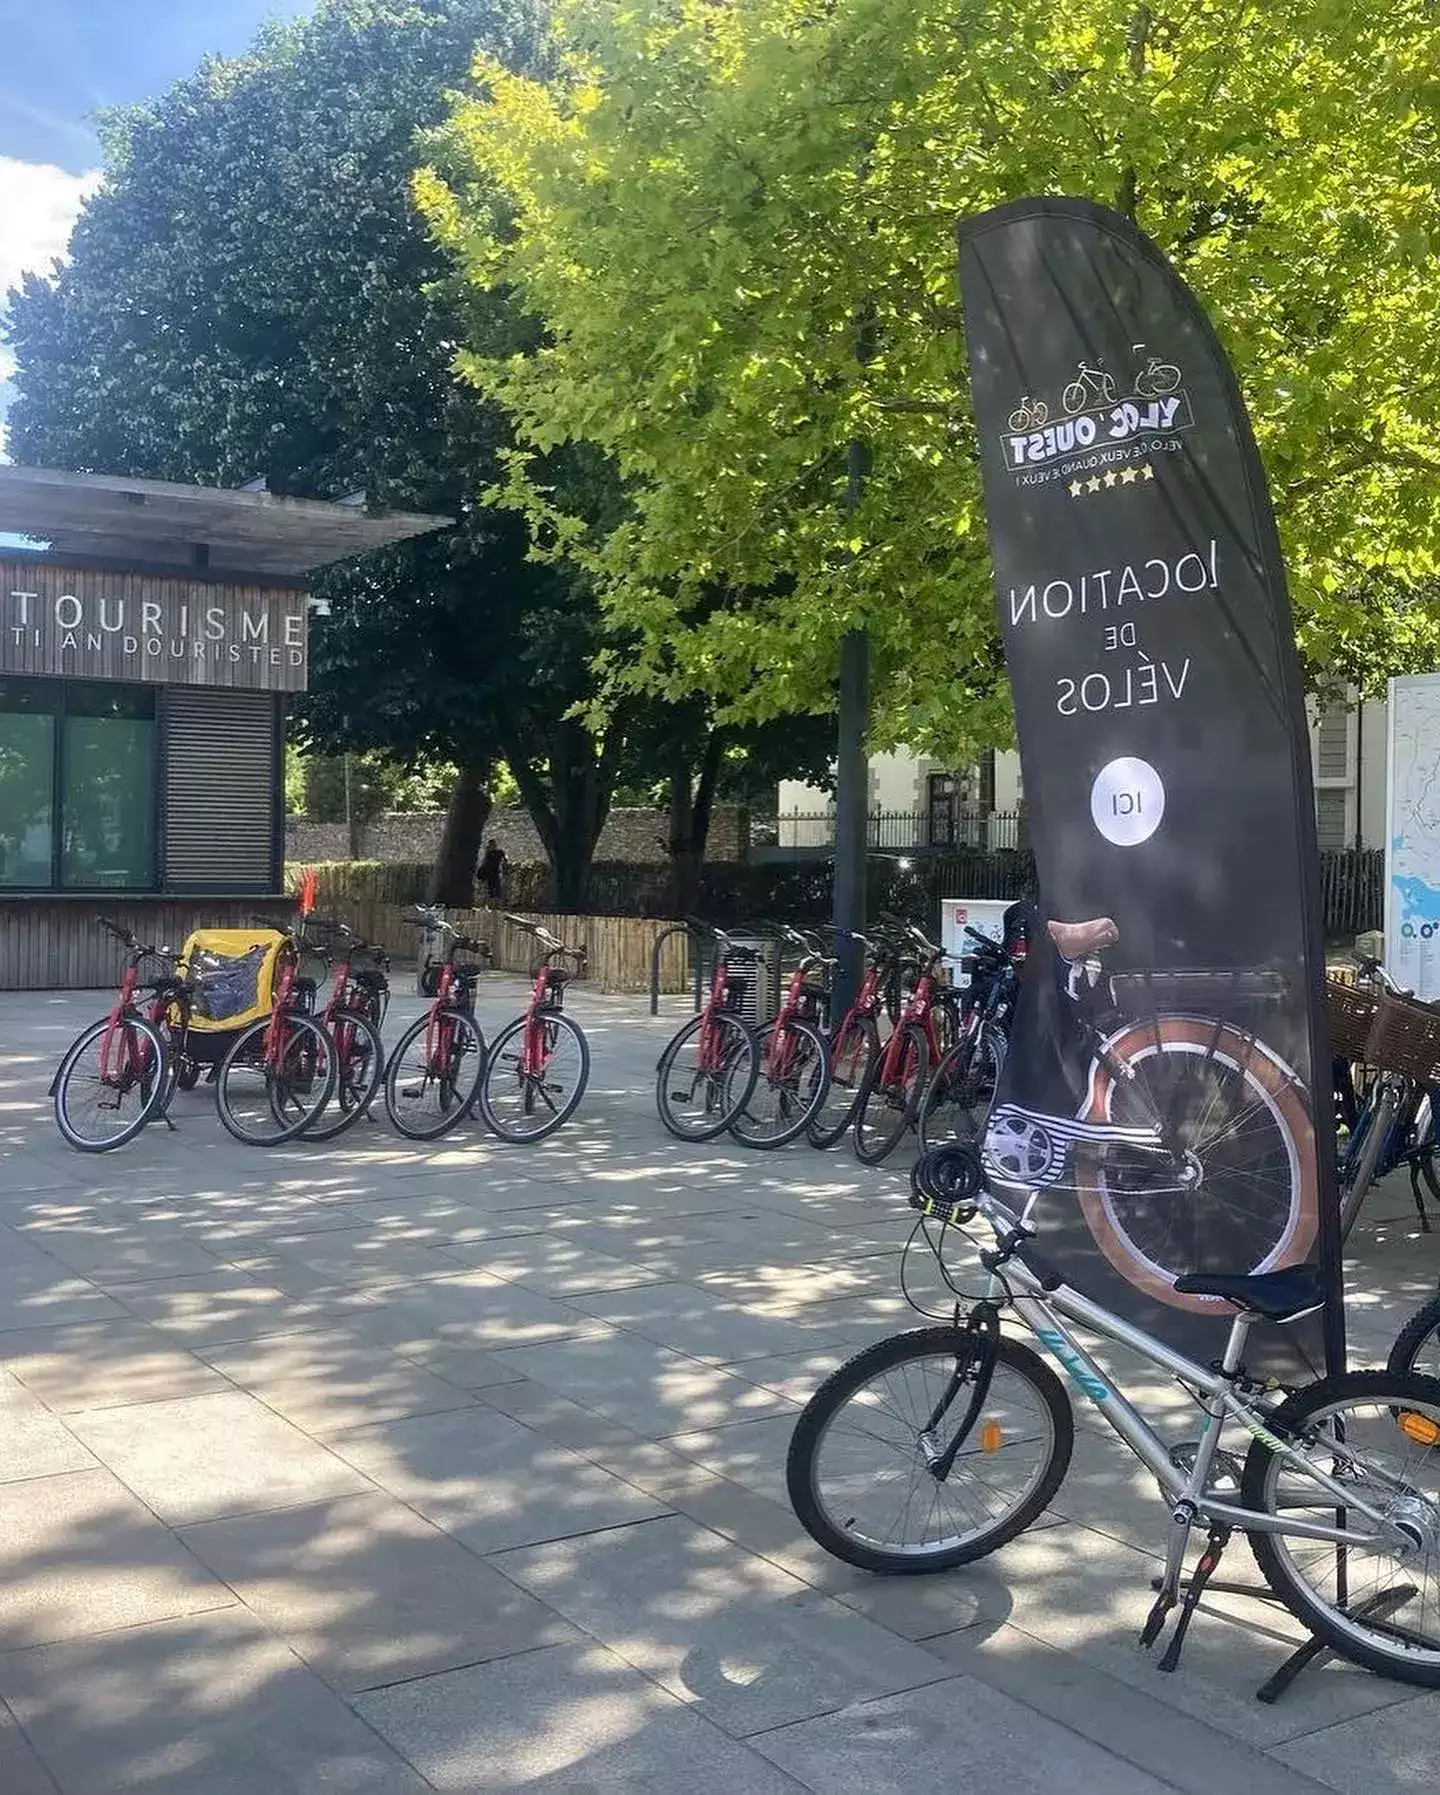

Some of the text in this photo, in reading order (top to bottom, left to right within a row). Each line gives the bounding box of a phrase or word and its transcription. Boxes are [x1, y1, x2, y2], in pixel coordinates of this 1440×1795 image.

[10, 591, 303, 647] TOURISME
[11, 627, 303, 666] TI AN DOURISTED
